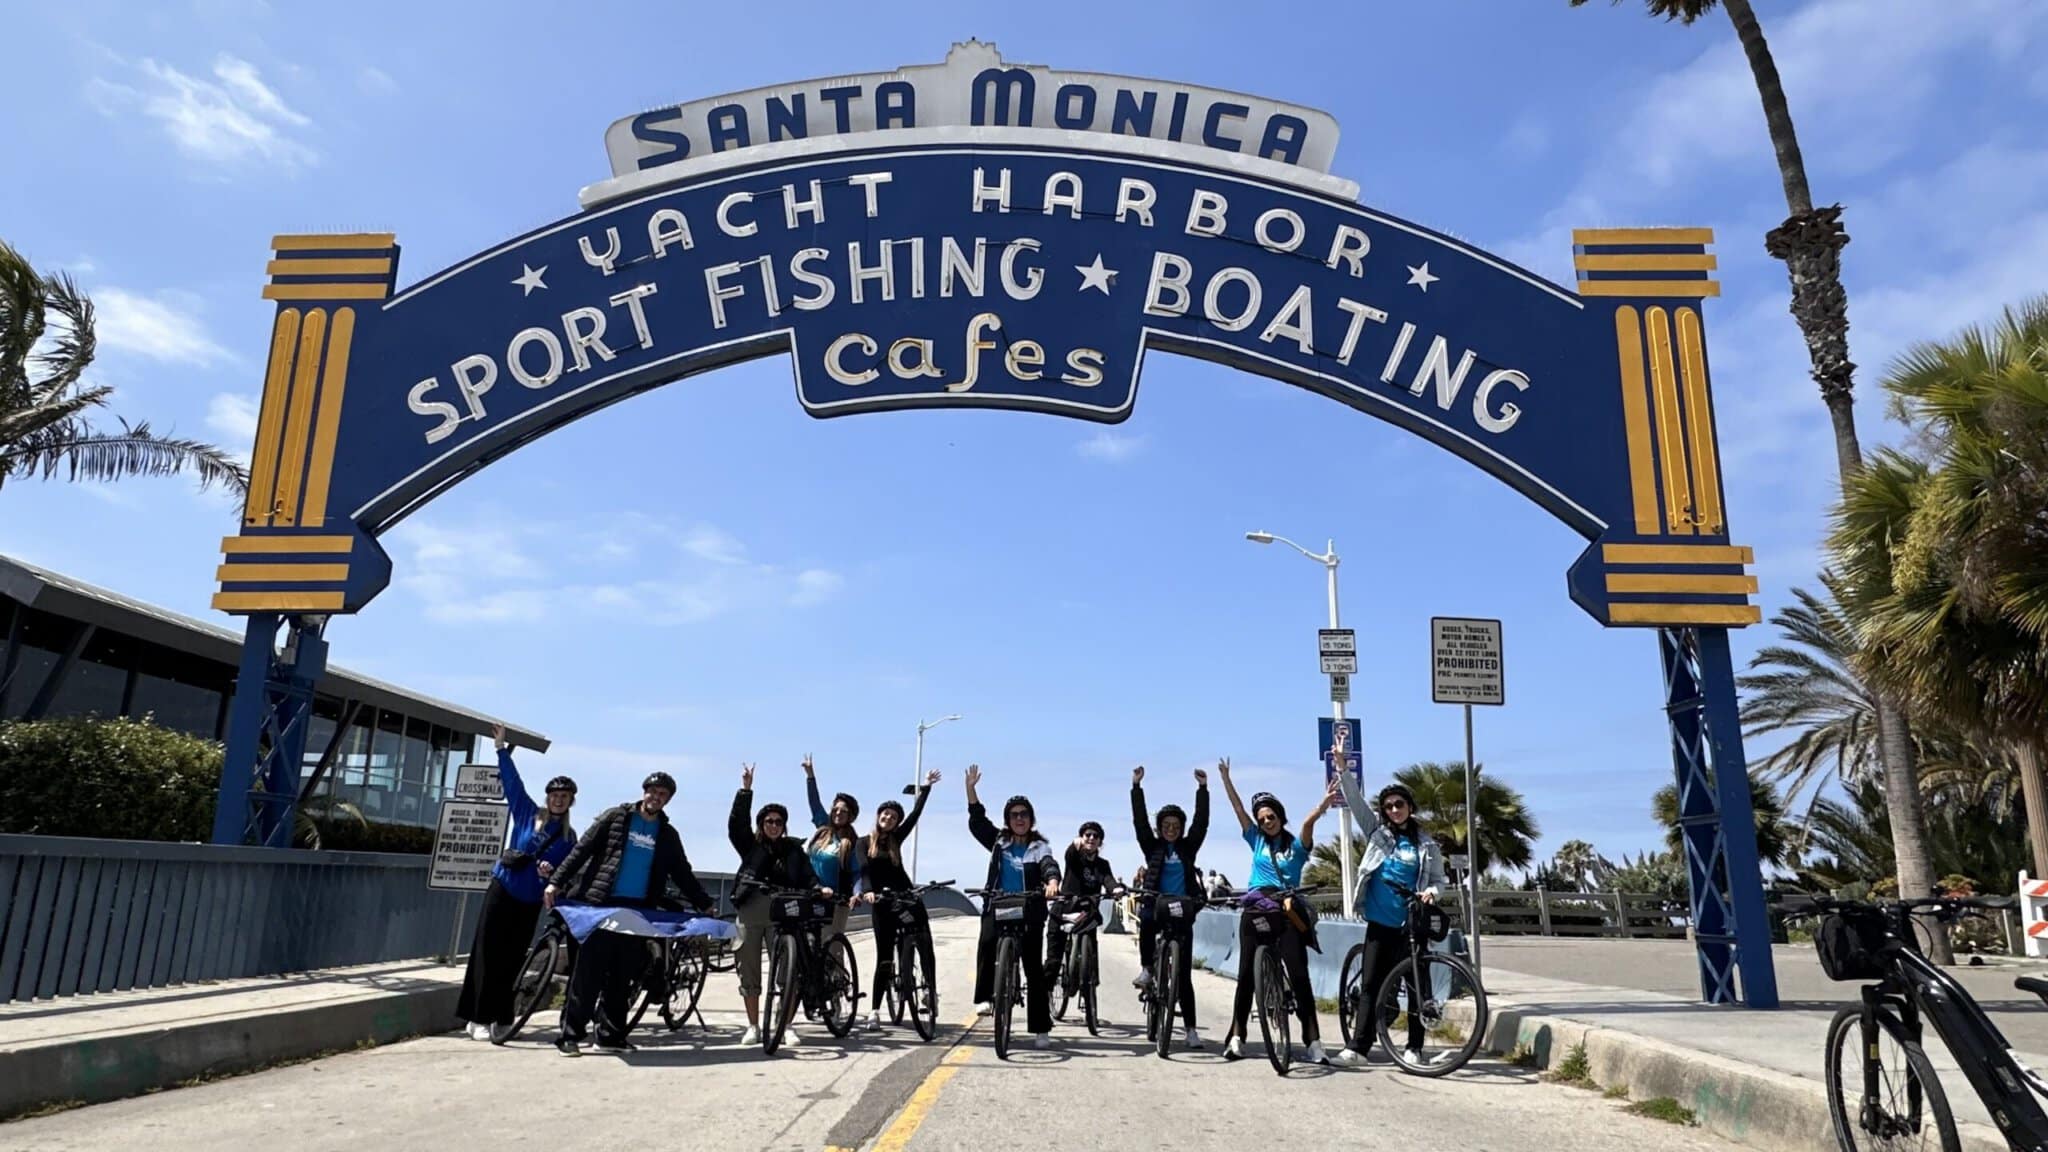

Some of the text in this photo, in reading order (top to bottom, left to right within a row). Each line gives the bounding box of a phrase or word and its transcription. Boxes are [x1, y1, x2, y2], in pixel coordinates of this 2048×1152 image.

[631, 67, 1308, 171] SANTA MONICA
[578, 167, 1371, 278] YACHT HARBOR
[407, 236, 1530, 445] SPORT FISHING BOATING
[824, 312, 1106, 392] cafes
[1437, 657, 1498, 670] PROHIBITED
[1333, 676, 1346, 685] NO
[474, 770, 489, 780] USE
[458, 783, 502, 795] CROSSWALK
[439, 842, 499, 855] PROHIBITED
